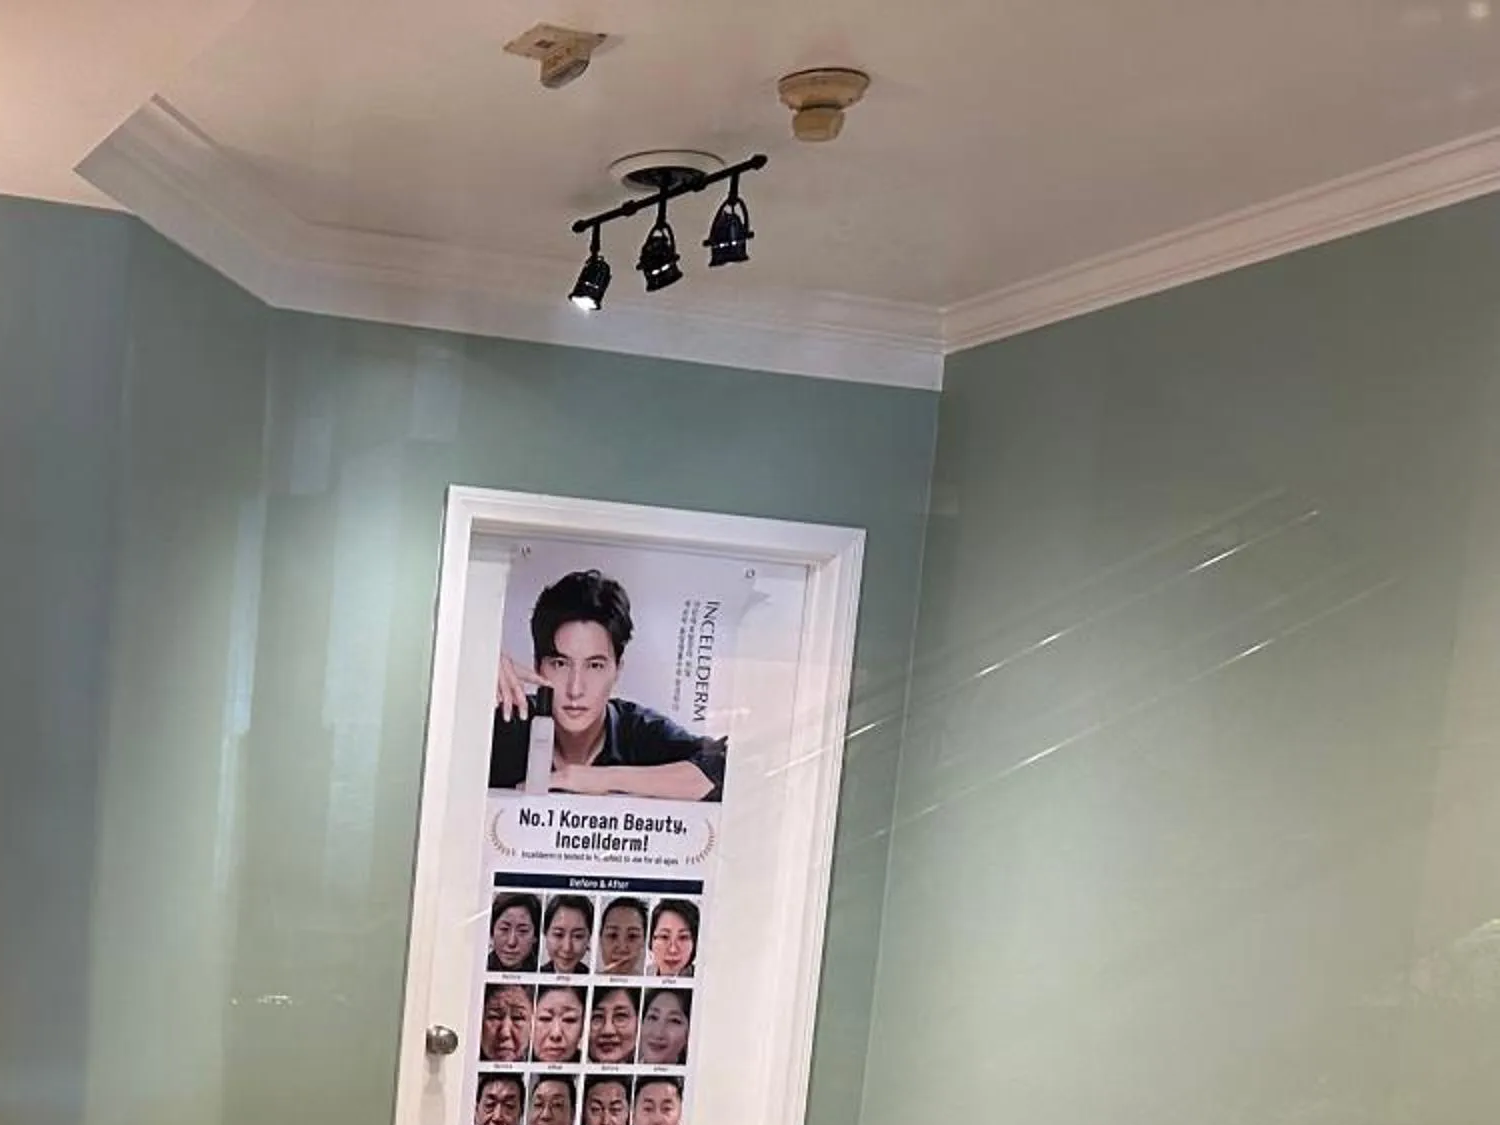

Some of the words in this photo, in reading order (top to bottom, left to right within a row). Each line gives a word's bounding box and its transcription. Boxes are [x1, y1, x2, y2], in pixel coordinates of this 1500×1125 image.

[691, 601, 721, 722] INCELLDERM
[519, 808, 554, 828] No.1
[560, 810, 619, 831] Korean
[555, 831, 649, 852] Incellderm!
